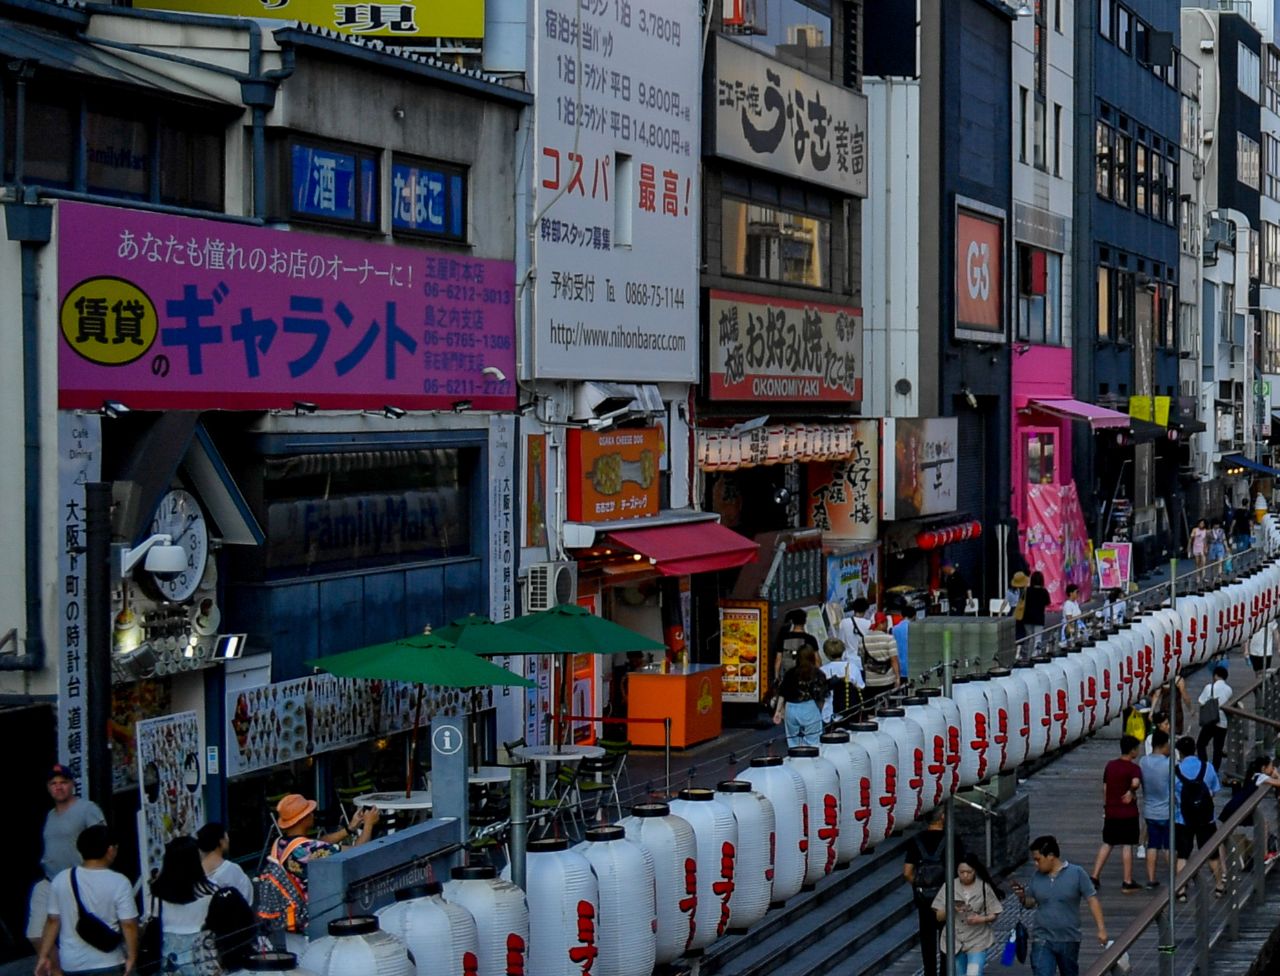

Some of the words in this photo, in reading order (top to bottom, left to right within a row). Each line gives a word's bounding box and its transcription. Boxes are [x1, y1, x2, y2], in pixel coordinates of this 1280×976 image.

[638, 8, 681, 47] 3,780円
[610, 71, 631, 102] 平日
[610, 111, 631, 141] 平日
[312, 155, 337, 212] 酒
[542, 147, 610, 202] コスパ
[541, 217, 611, 251] 幹部スタッフ募集
[966, 240, 991, 301] G3
[551, 271, 595, 303] 予約受付
[625, 281, 684, 309] 0868-75-1144
[74, 296, 145, 347] 賃貸
[160, 280, 418, 380] ギャラント
[550, 318, 686, 352] http://www.nihonbaracc.com
[151, 353, 171, 379] の
[752, 379, 820, 397] OKONOMIYAKI
